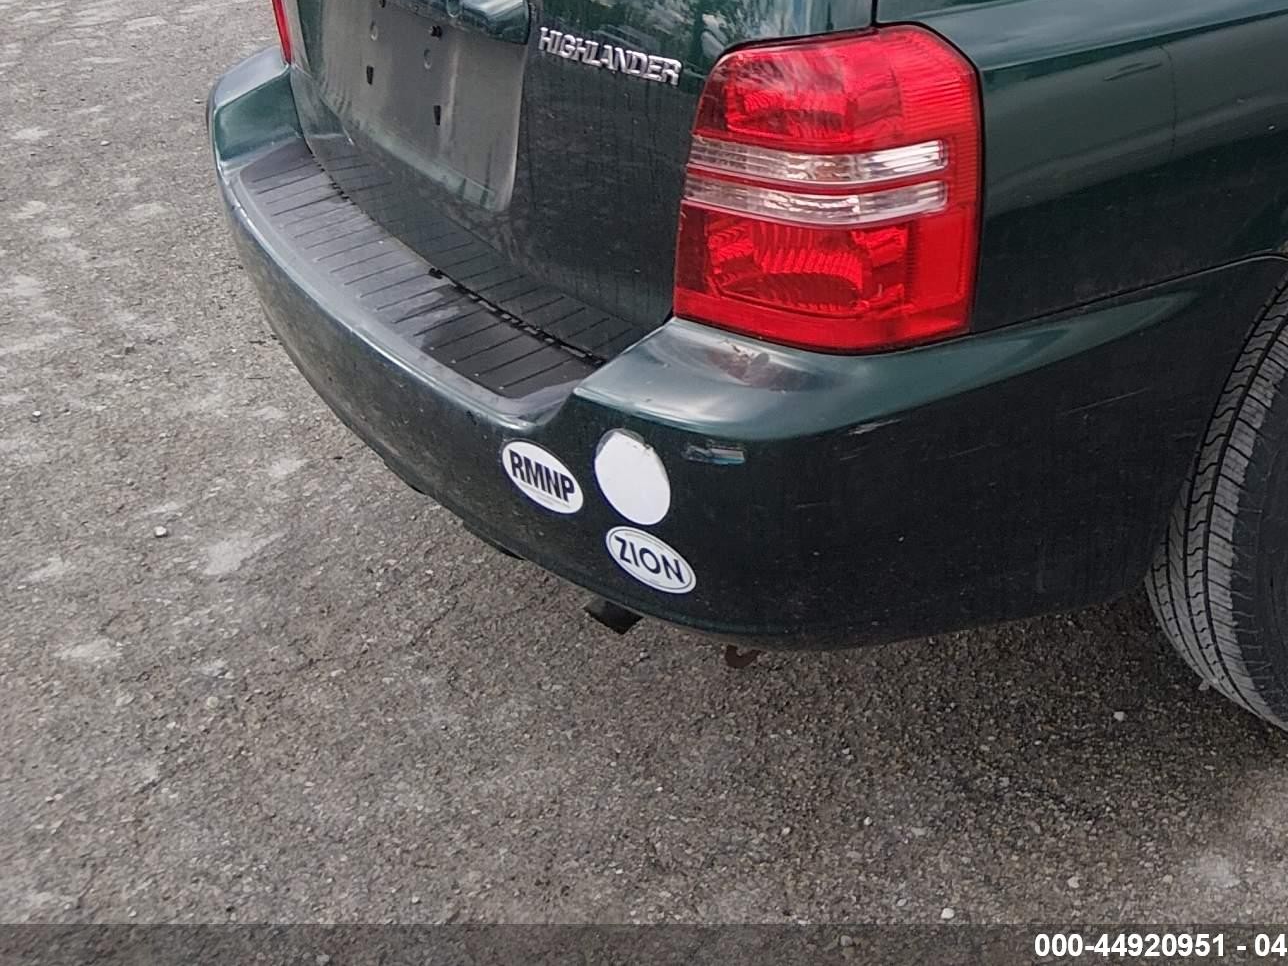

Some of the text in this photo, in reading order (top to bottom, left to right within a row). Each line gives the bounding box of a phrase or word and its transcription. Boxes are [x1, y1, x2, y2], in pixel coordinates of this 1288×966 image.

[538, 26, 683, 85] HIGHLANDER
[509, 449, 576, 503] RMNP
[614, 535, 686, 584] ZION
